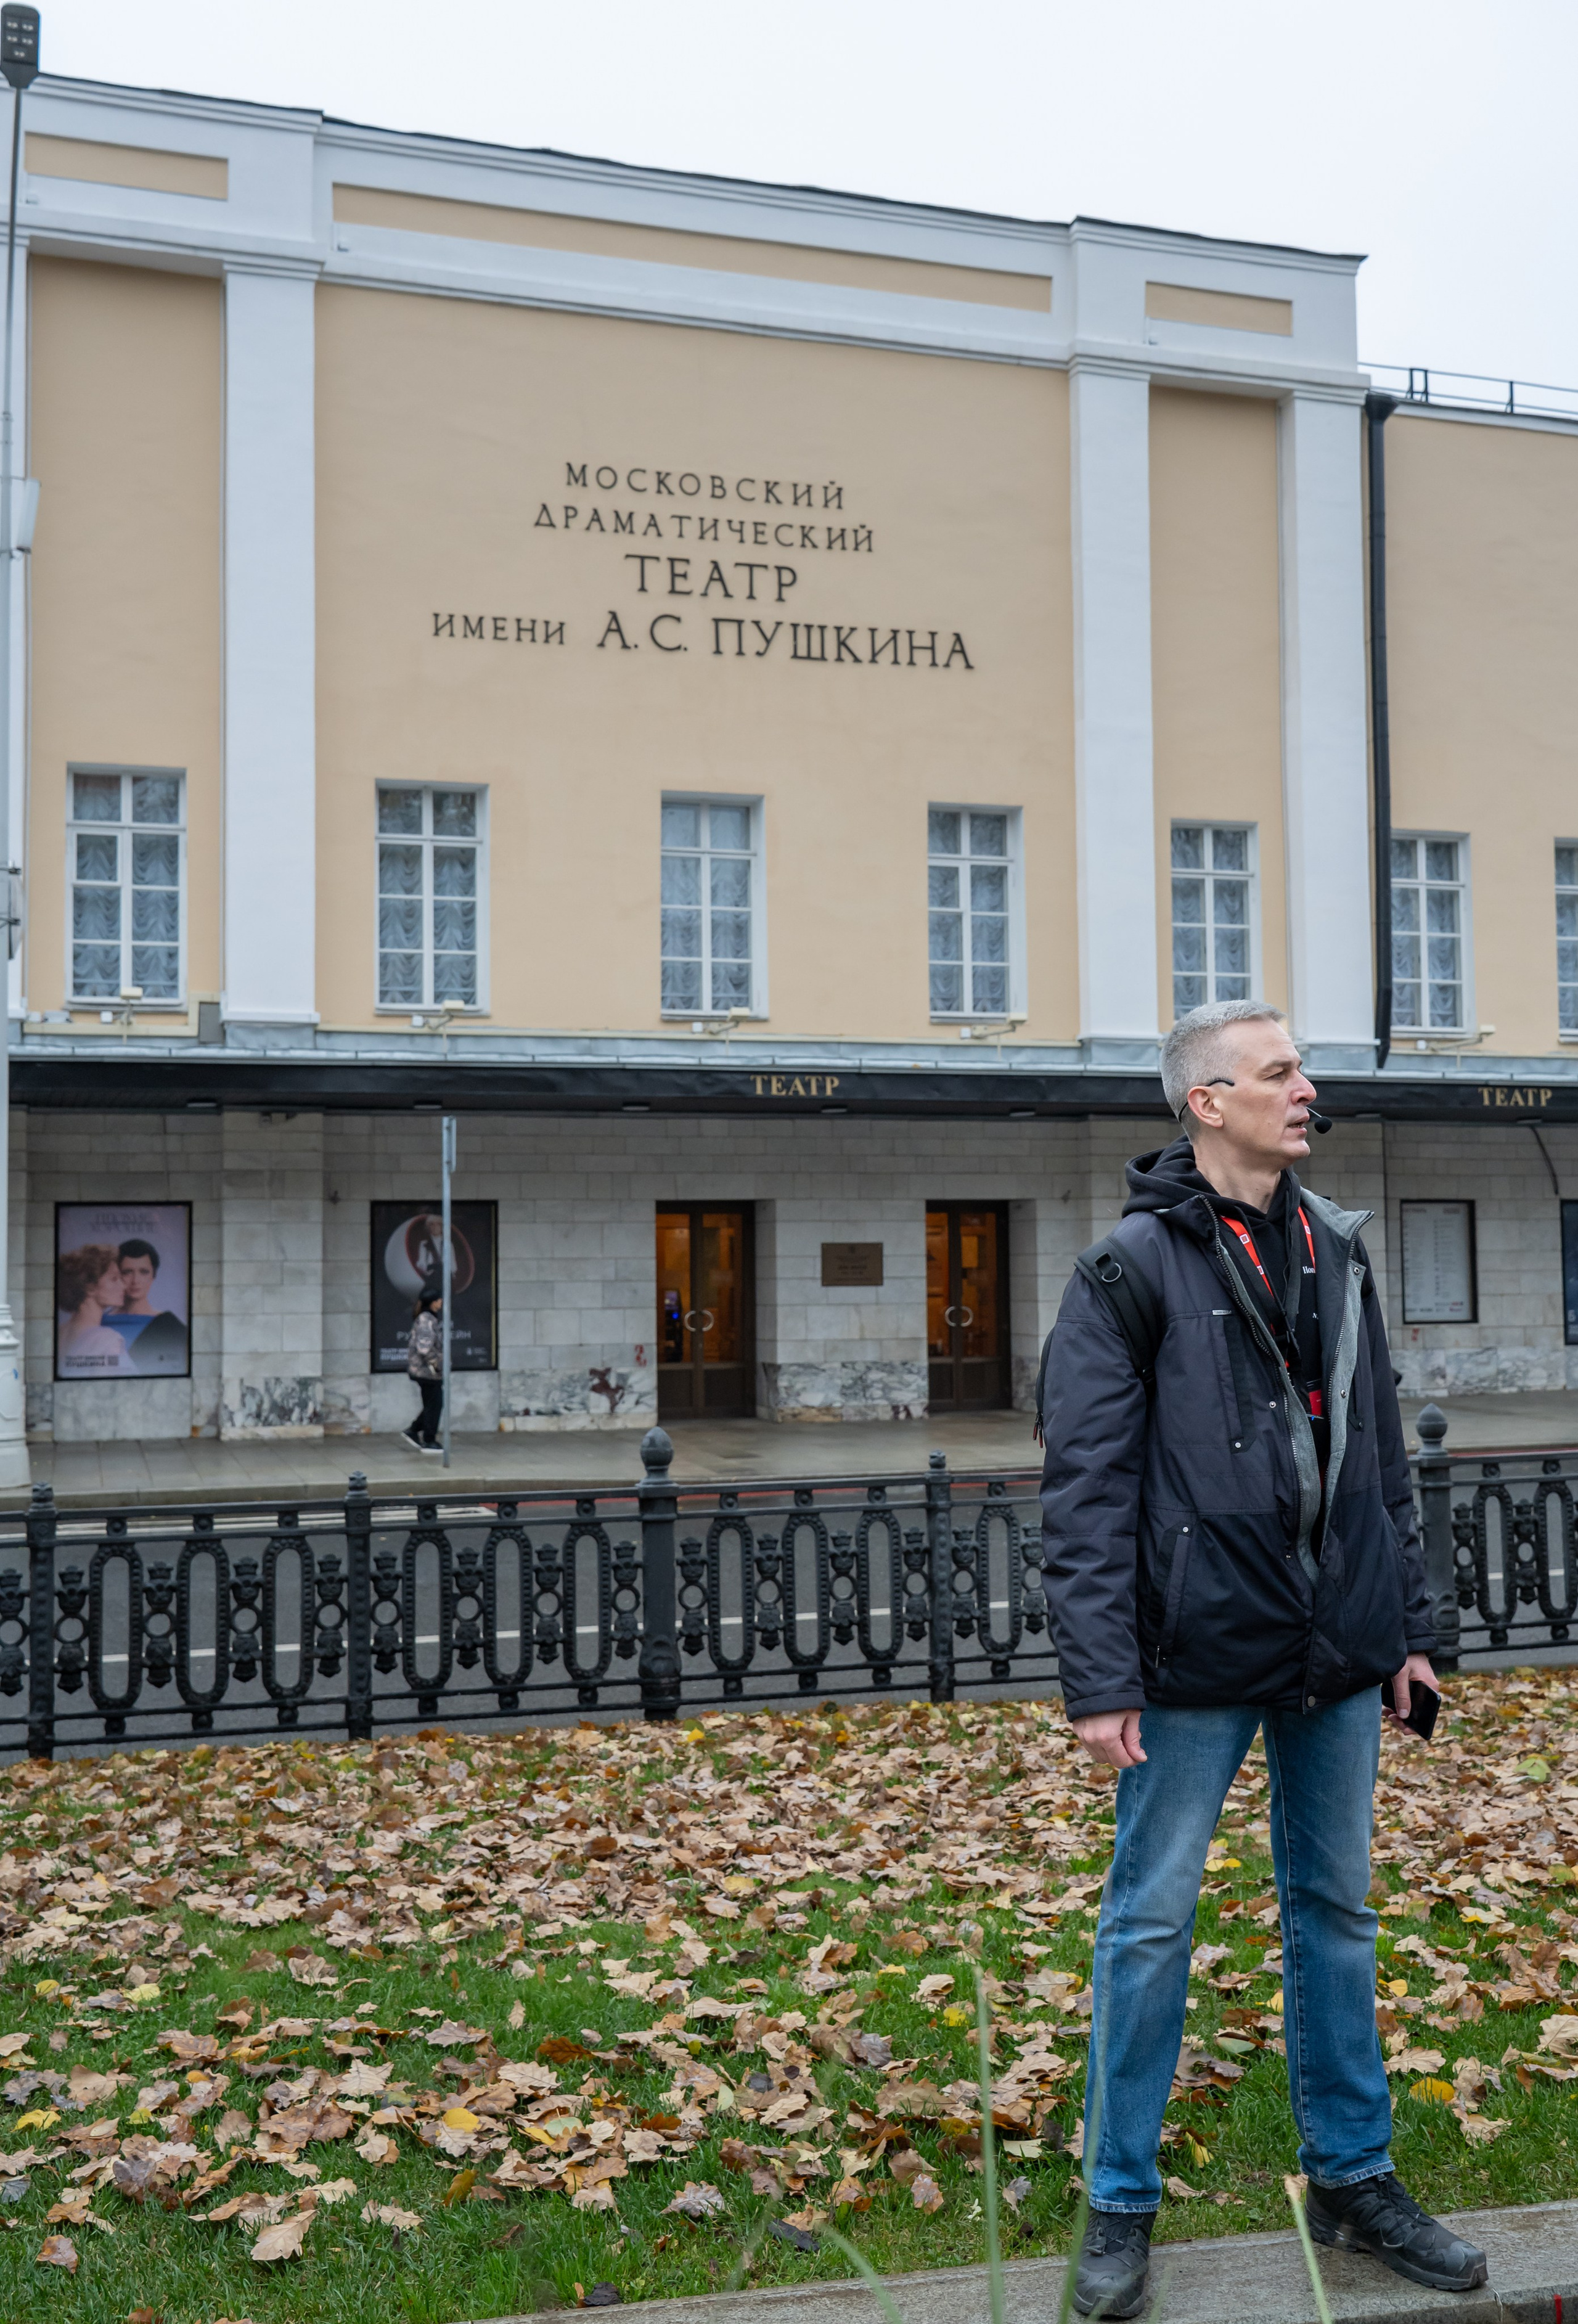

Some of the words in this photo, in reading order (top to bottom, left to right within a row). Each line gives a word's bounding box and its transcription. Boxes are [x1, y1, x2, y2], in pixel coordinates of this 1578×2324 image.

[565, 461, 844, 510] МОСКОВСКИЙ
[533, 502, 875, 554] ДРАМАТИЧЕСКИЙ
[624, 553, 798, 604] ТЕАТР
[431, 612, 566, 646] ИМЕНИ
[711, 616, 976, 671] ПУШКИНА
[750, 1074, 840, 1096] ТЕАТР
[1478, 1087, 1552, 1107] ТЕАТР
